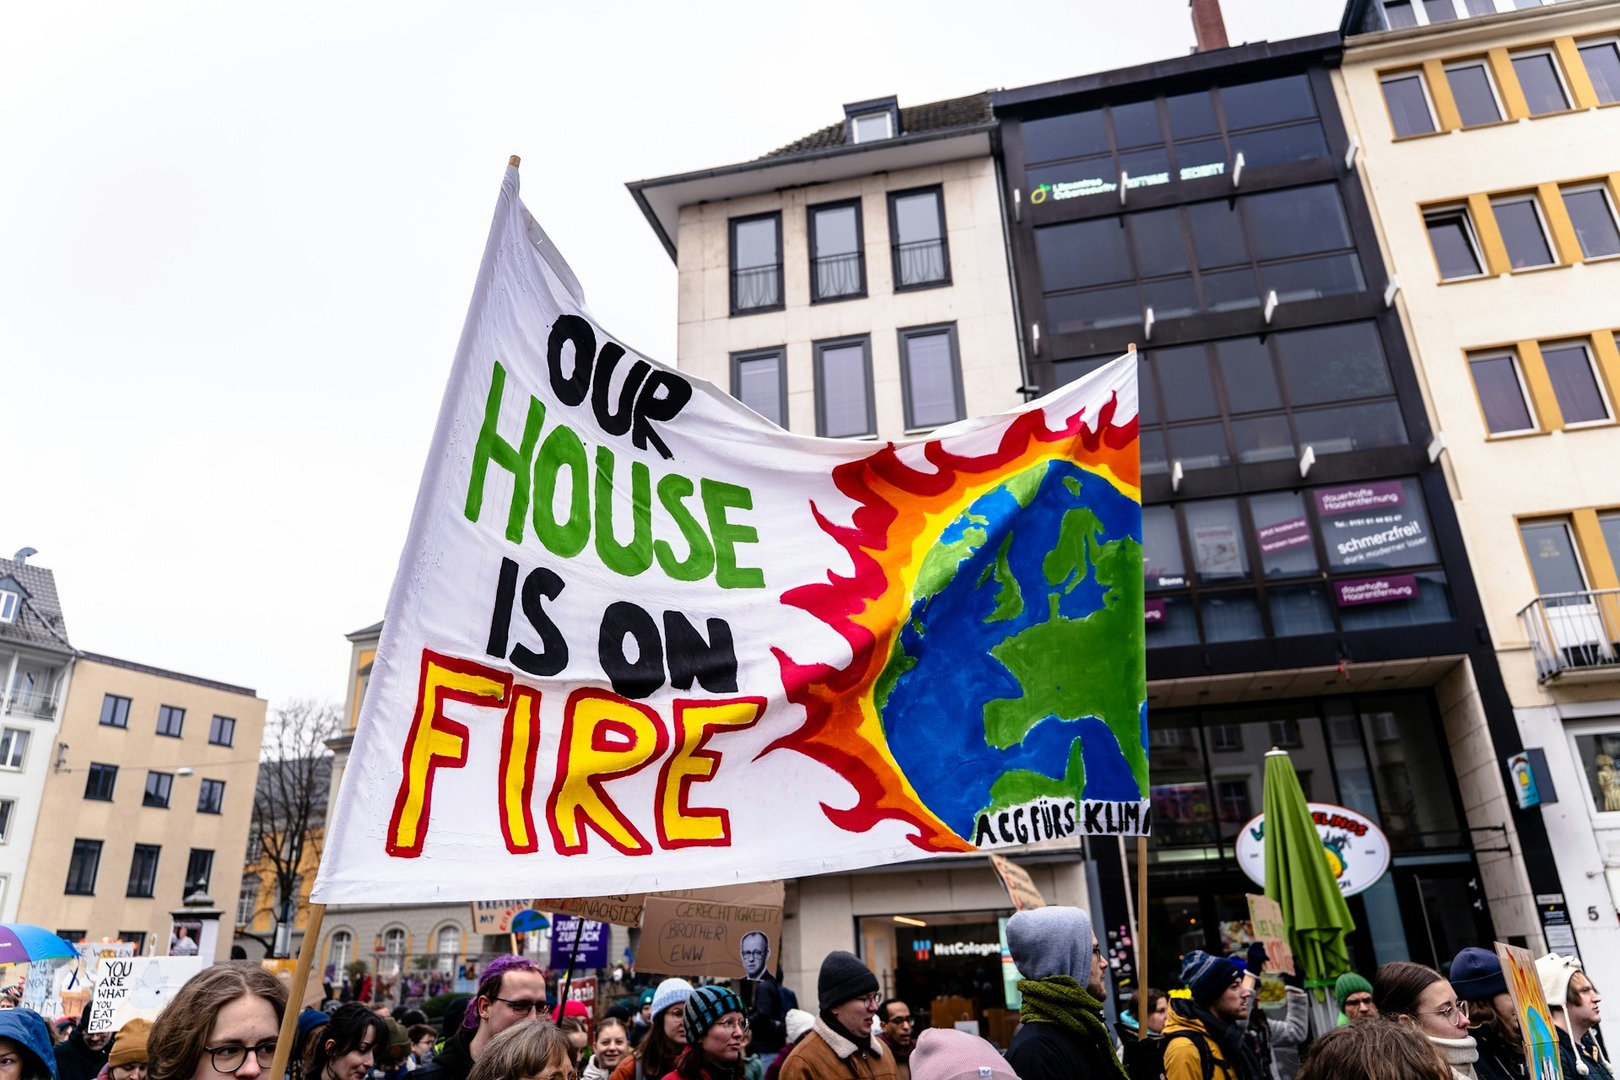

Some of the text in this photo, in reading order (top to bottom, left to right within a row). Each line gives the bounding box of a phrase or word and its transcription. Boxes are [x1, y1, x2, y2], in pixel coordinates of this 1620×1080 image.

[547, 315, 692, 460] OUR
[465, 360, 766, 589] HOUSE
[1338, 520, 1421, 555] schmerzfrei!
[486, 557, 739, 699] IS ON
[386, 648, 767, 858] FIRE
[1588, 906, 1599, 921] 5
[666, 922, 724, 940] BROTHER
[670, 944, 704, 962] EWW
[106, 961, 132, 977] YOU
[99, 977, 124, 987] ARE
[98, 989, 128, 999] WHAT
[93, 1009, 115, 1019] EAT
[97, 1001, 112, 1009] YOU
